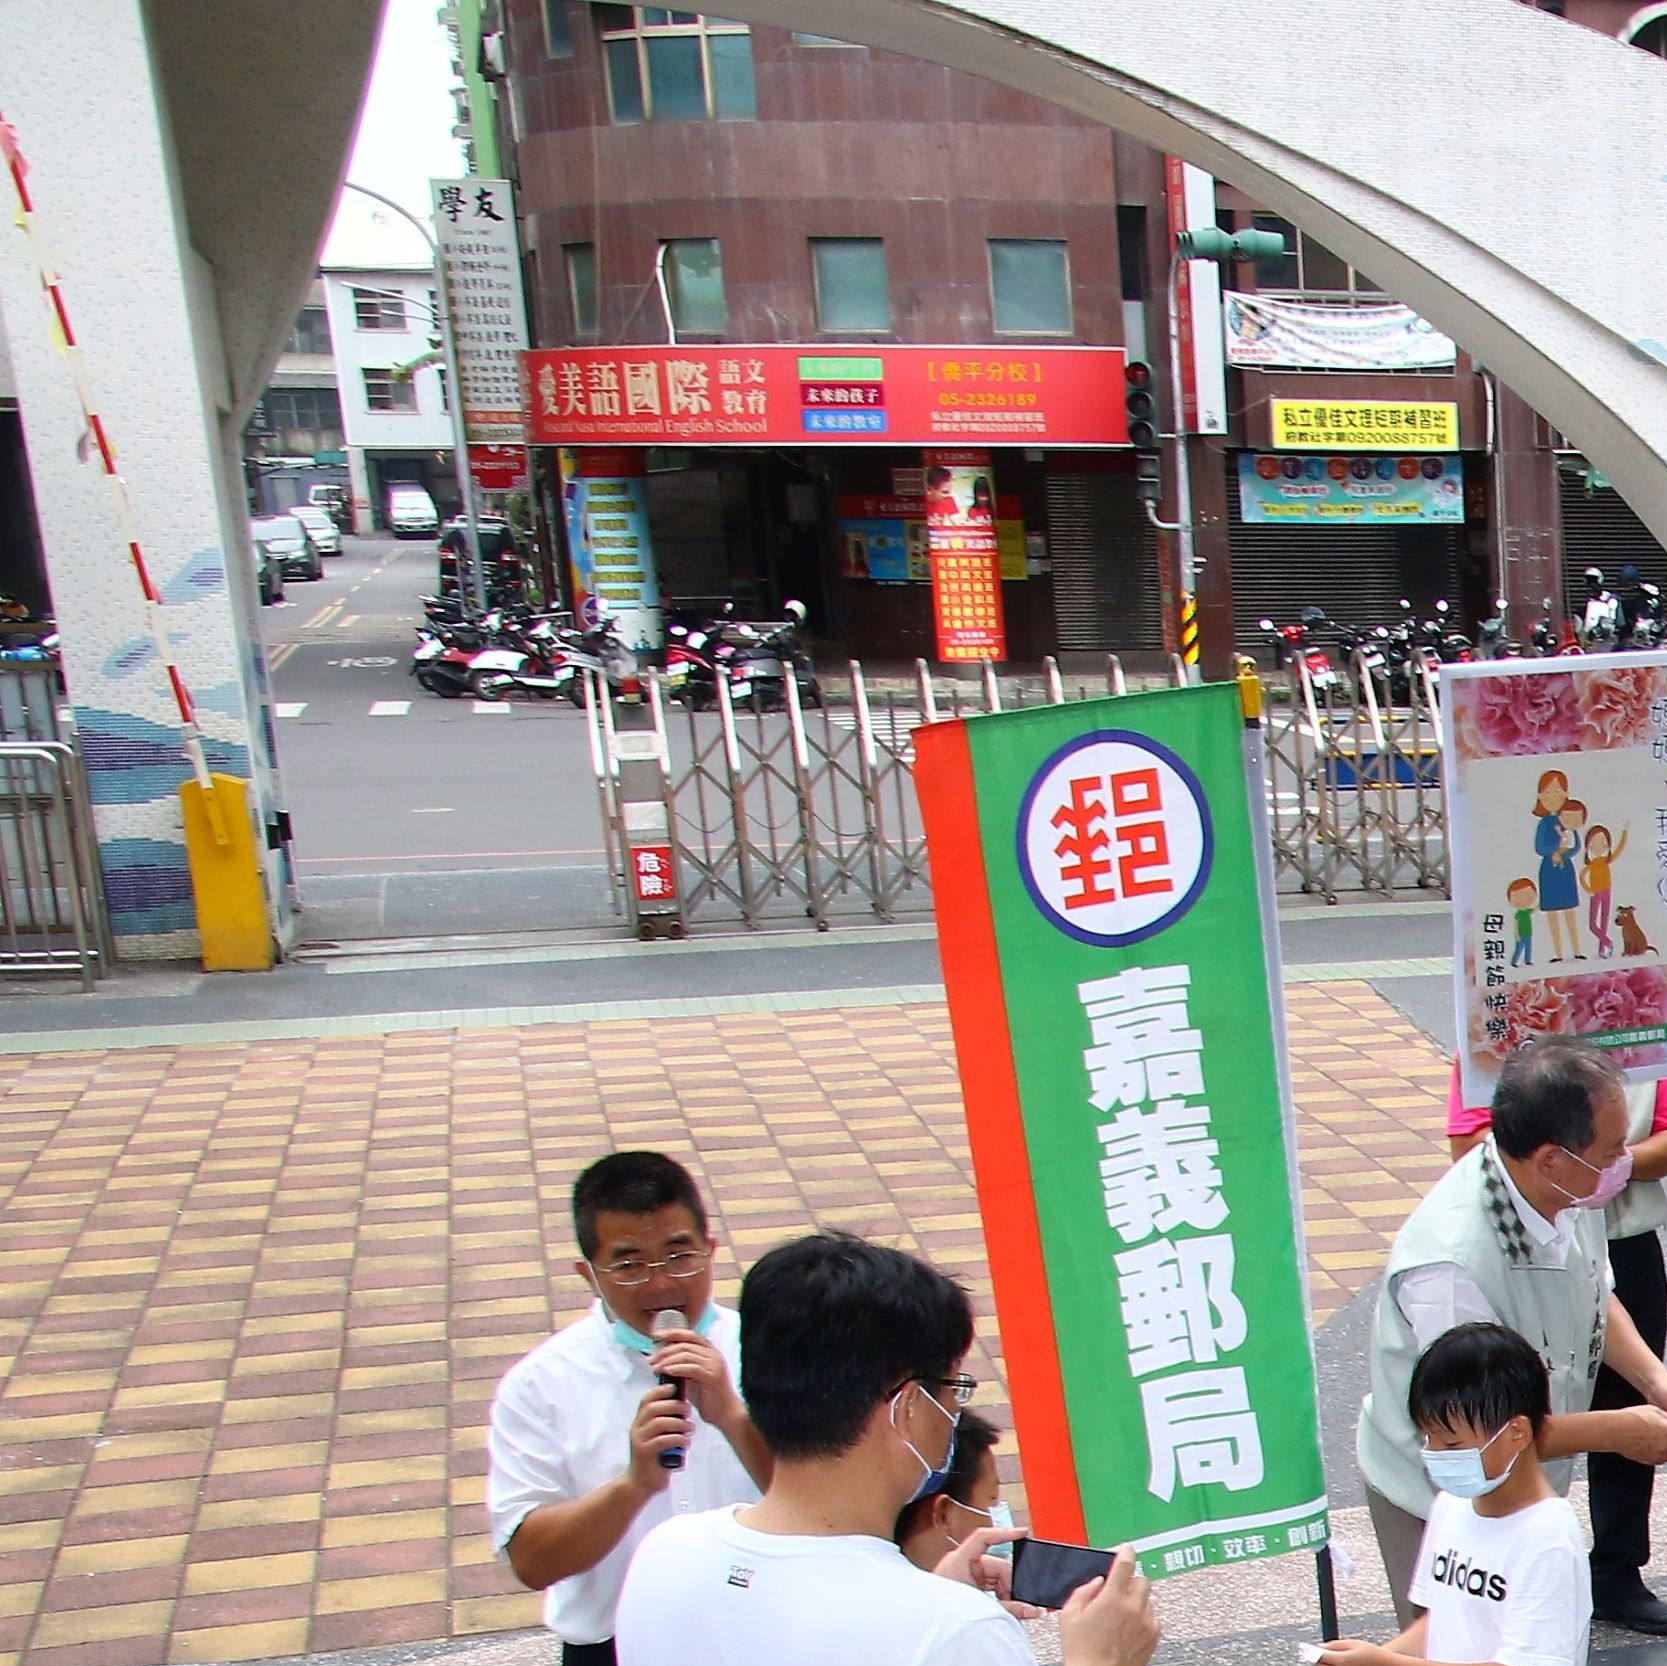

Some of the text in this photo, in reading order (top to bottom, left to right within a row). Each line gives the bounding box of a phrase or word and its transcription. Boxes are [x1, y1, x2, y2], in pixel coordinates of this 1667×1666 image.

[439, 186, 505, 222] 學友
[538, 360, 712, 416] 愛美語國際
[718, 359, 767, 384] 語文
[721, 389, 768, 415] 教育
[665, 420, 714, 436] English
[717, 418, 767, 433] School
[637, 851, 665, 897] 危險
[1482, 911, 1508, 1042] 母親節快樂
[1077, 963, 1265, 1504] 嘉義郵局
